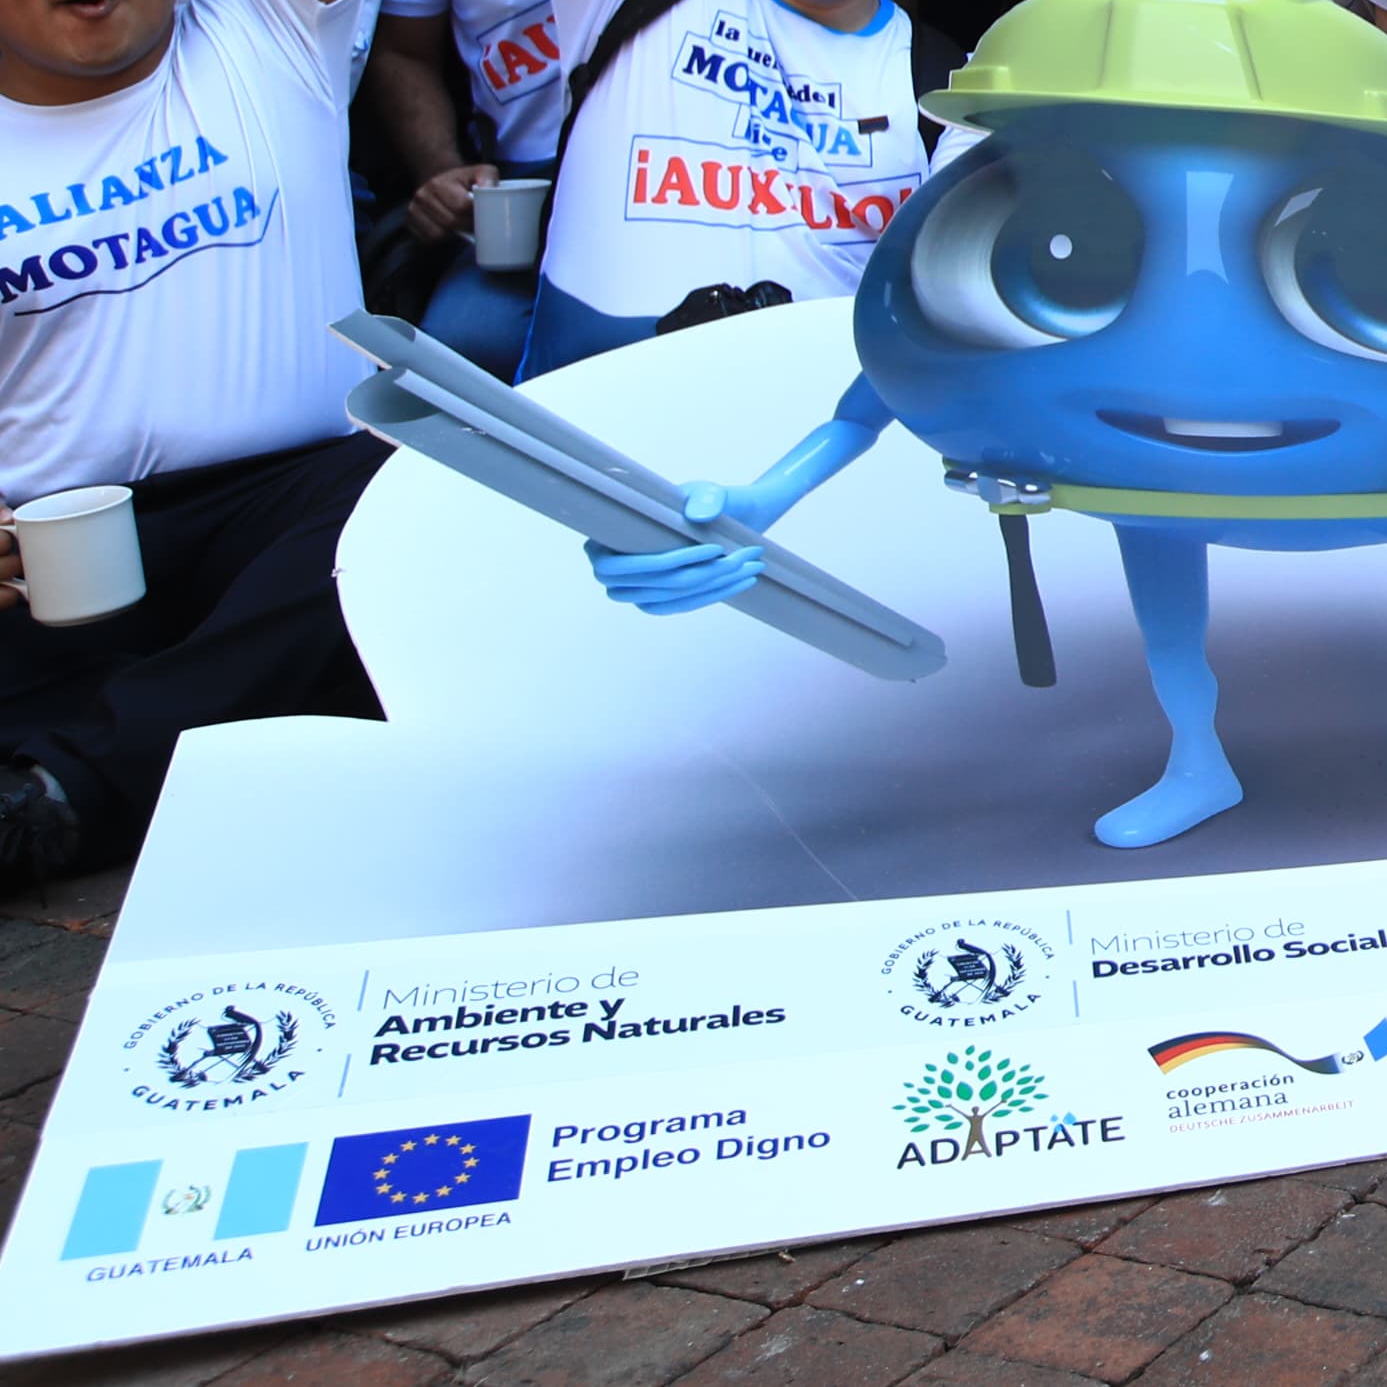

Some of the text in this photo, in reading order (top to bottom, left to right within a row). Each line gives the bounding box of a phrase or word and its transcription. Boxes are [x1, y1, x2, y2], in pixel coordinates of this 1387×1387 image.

[715, 18, 741, 43] la
[0, 135, 229, 241] ALIANZA
[0, 186, 262, 304] MOTAGUA
[881, 918, 1056, 977] GOBIERNO DE LA REPÚBLICA
[1090, 918, 1306, 956] Ministerio de
[1092, 942, 1277, 980] Desarrollo
[382, 965, 641, 1011] Ministerio de
[899, 991, 1042, 1028] GUATEMALA
[123, 992, 205, 1050] GOBIERNO
[212, 983, 238, 997] DE
[245, 981, 268, 992] LA
[275, 981, 338, 1031] REPÚBLICA
[369, 1004, 787, 1066] Recursos Naturales
[373, 996, 627, 1039] Ambiente y
[131, 1068, 306, 1113] GUATEMALA
[1165, 1073, 1295, 1101] cooperación
[1167, 1089, 1289, 1120] alemana
[551, 1108, 748, 1149] Programa
[1168, 1099, 1356, 1134] DEUTSCHE ZUSAMMENARBEIT
[546, 1130, 832, 1183] Empleo Digno
[304, 1210, 513, 1253] UNIÓN EUROPEA
[85, 1245, 255, 1283] GUATEMALA
